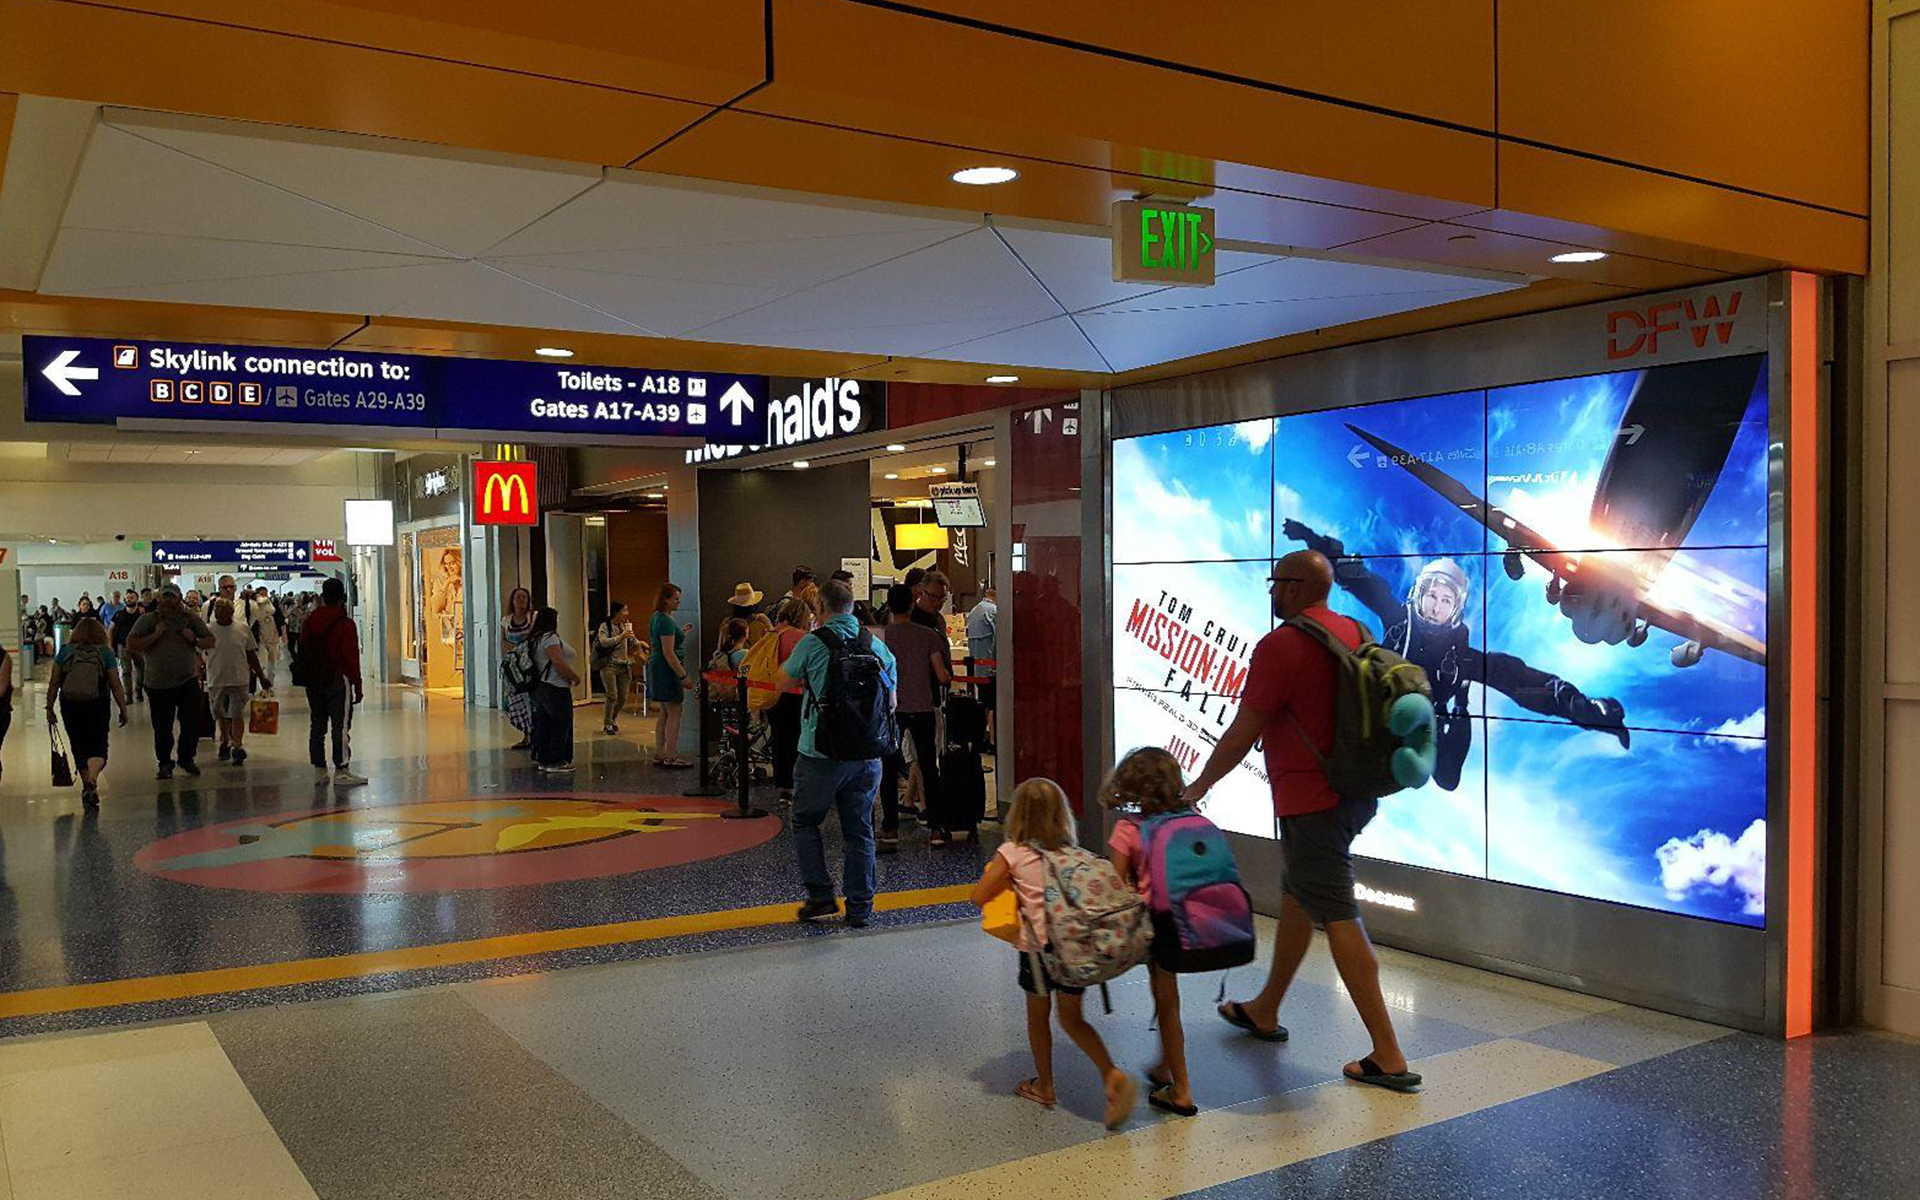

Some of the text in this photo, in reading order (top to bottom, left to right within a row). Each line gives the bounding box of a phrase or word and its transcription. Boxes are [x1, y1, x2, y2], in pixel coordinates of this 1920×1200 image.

[1141, 209, 1203, 272] EXIT
[1607, 292, 1742, 359] DFW
[149, 348, 410, 380] Skylink connection to:
[558, 371, 622, 391] Toilets
[641, 376, 680, 394] A18
[156, 383, 169, 399] B
[185, 384, 198, 400] C
[214, 385, 227, 401] D
[244, 386, 256, 402] E
[304, 389, 350, 408] Gates
[355, 391, 426, 411] A29-A39
[531, 398, 680, 422] Gates A17-A39
[686, 377, 861, 463] nald's
[109, 571, 128, 580] A18
[1158, 590, 1247, 659] TOM CRUI
[1164, 669, 1226, 726] FALL
